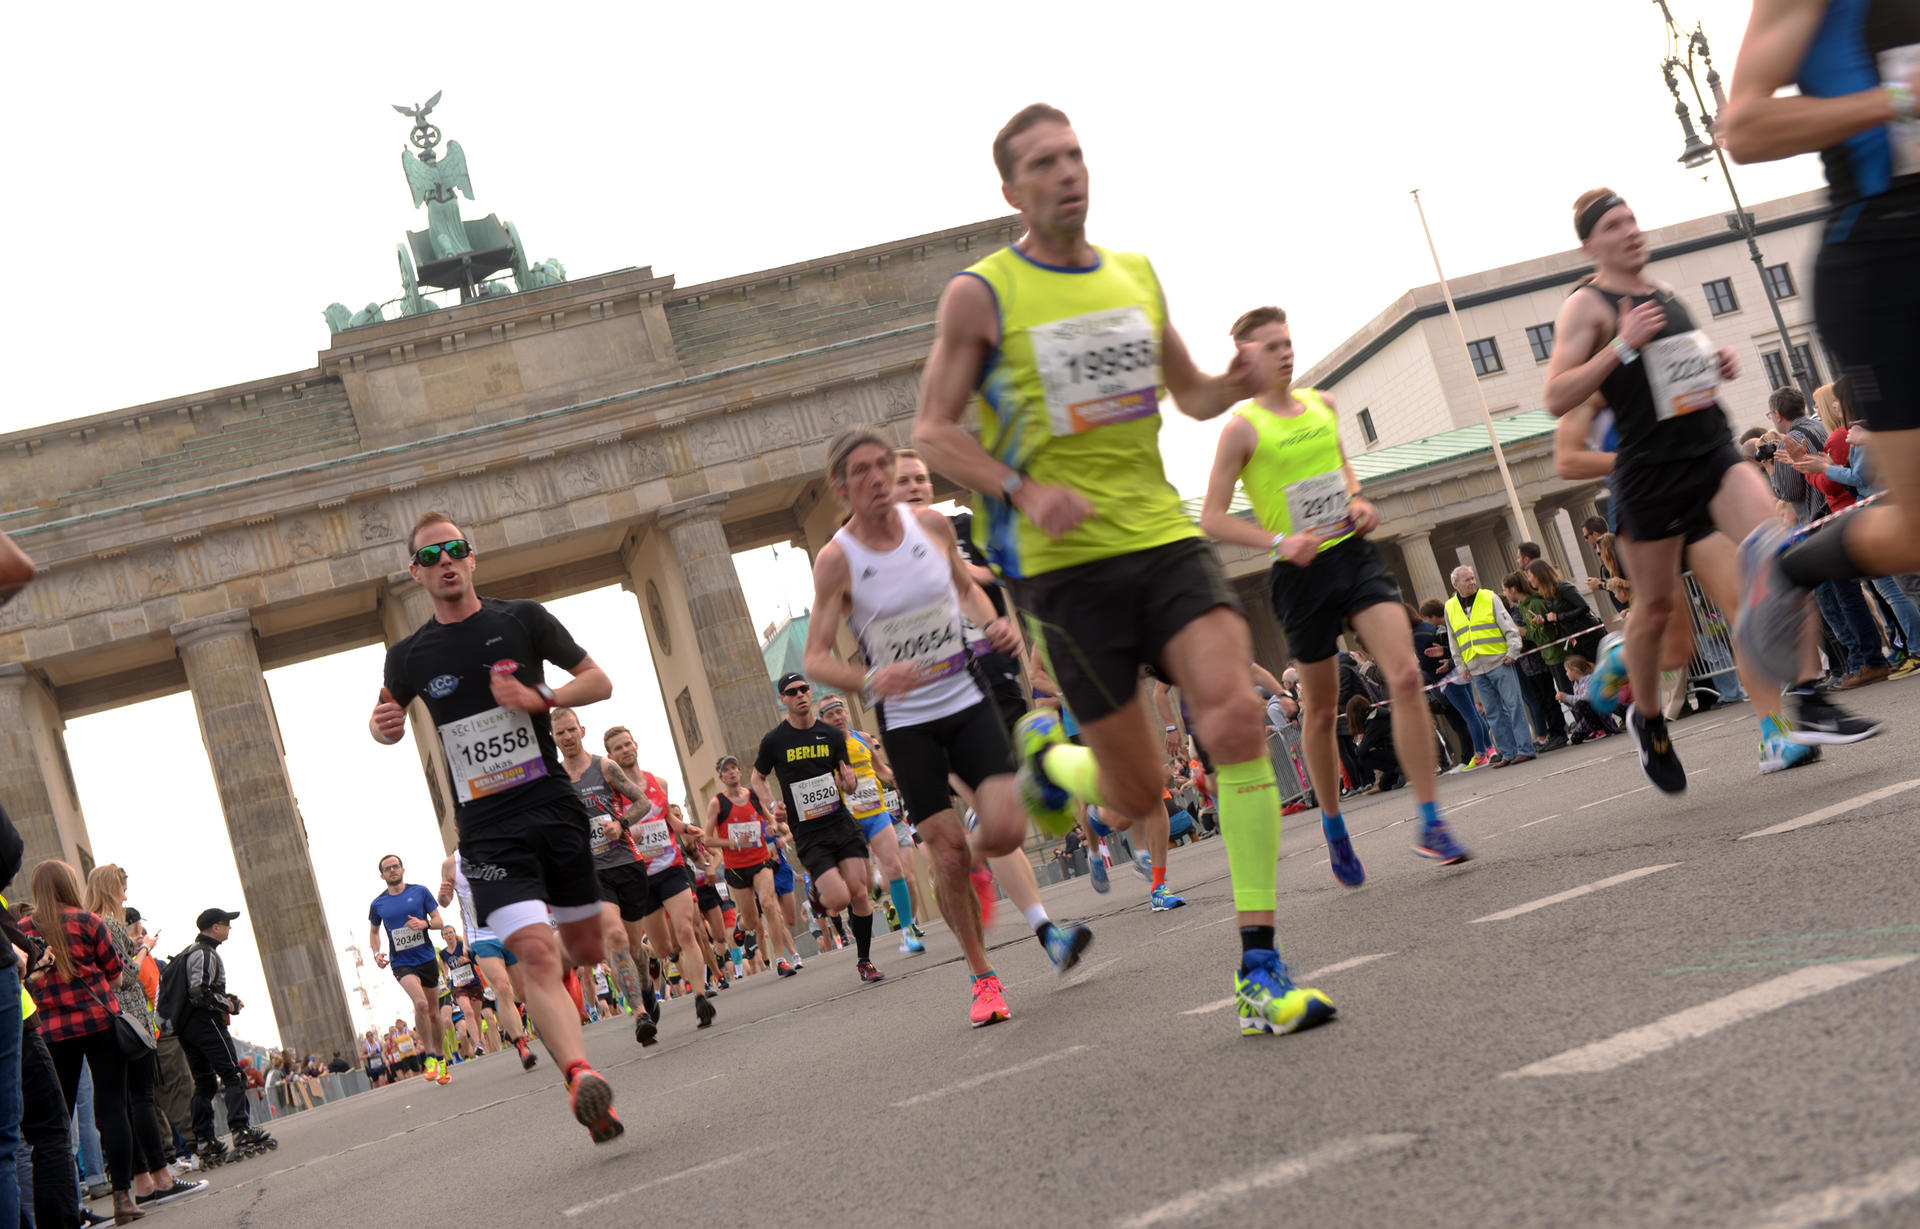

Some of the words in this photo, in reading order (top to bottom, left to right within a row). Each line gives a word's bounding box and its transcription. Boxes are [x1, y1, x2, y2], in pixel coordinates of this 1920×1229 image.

[430, 675, 454, 693] LCC
[476, 711, 516, 728] EVENTS
[462, 727, 529, 766] 18558
[786, 744, 830, 763] BERLIN
[482, 760, 513, 774] Lukas
[802, 785, 836, 804] 38520
